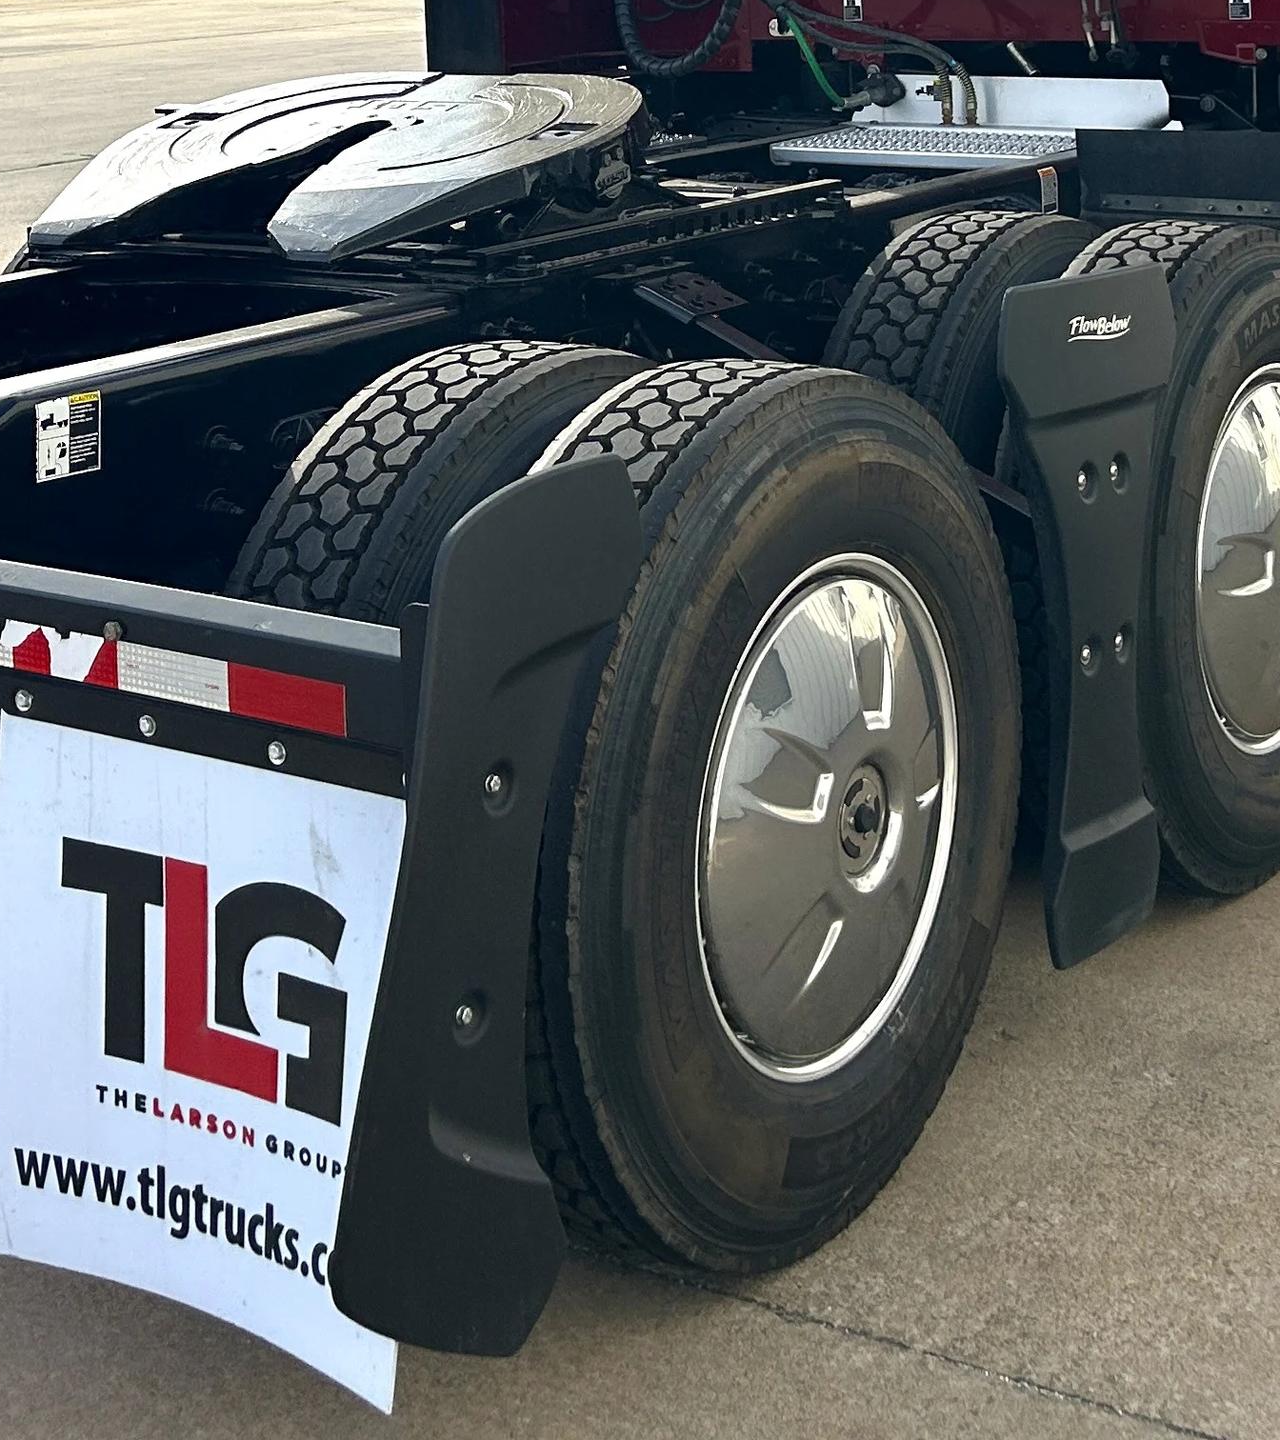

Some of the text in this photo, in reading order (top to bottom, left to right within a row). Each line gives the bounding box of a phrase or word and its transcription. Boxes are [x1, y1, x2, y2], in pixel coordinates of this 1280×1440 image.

[1070, 314, 1132, 336] FlowBelow
[61, 836, 348, 1127] TLG
[265, 1134, 342, 1179] GROUP
[13, 1147, 328, 1286] www.tlgtrucks.c
